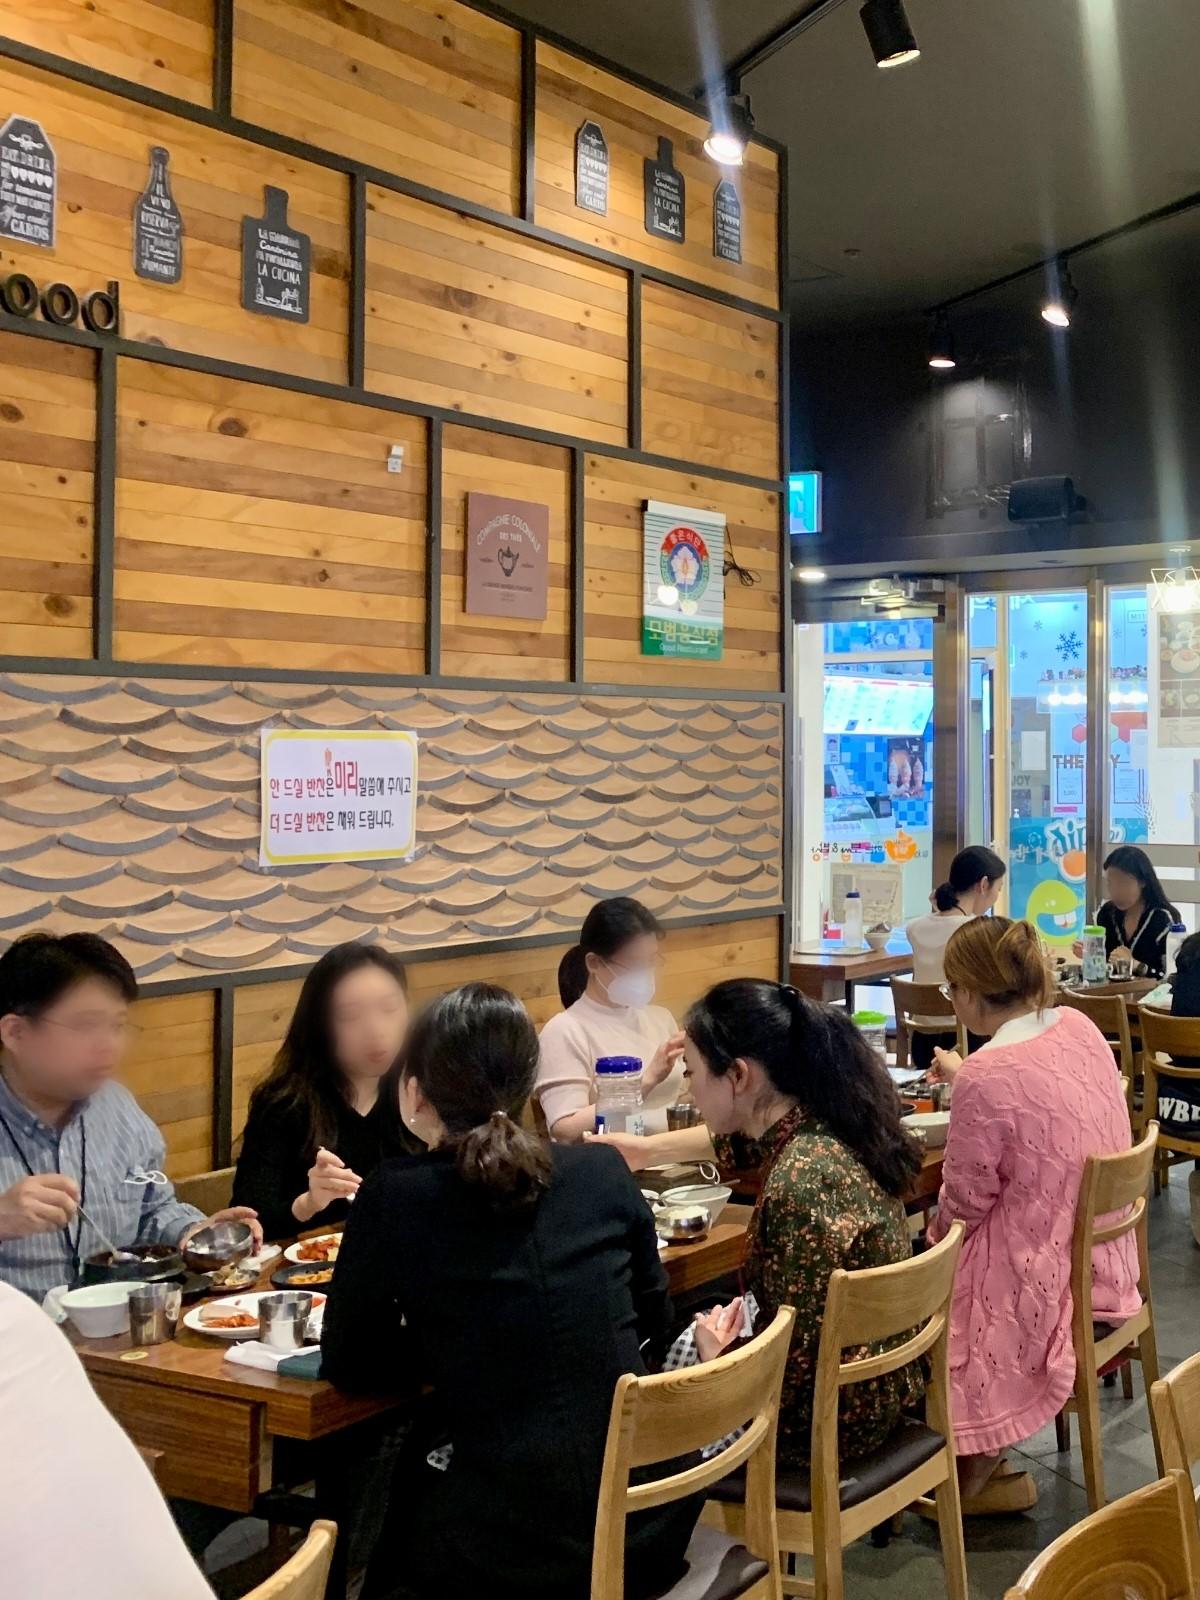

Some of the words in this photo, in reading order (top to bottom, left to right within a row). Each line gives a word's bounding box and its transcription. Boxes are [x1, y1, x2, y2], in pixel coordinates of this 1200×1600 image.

[257, 262, 268, 277] LA
[271, 266, 301, 286] CUCINA
[1, 272, 120, 335] ood
[1052, 754, 1085, 769] THE
[269, 778, 280, 799] 안
[283, 778, 303, 799] 드실
[306, 777, 335, 798] 반찬은
[334, 760, 358, 797] 미리
[387, 777, 412, 796] 주시고
[269, 813, 280, 833] 더
[283, 812, 303, 833] 드실
[306, 811, 335, 832] 반찬은
[337, 810, 356, 831] 채워
